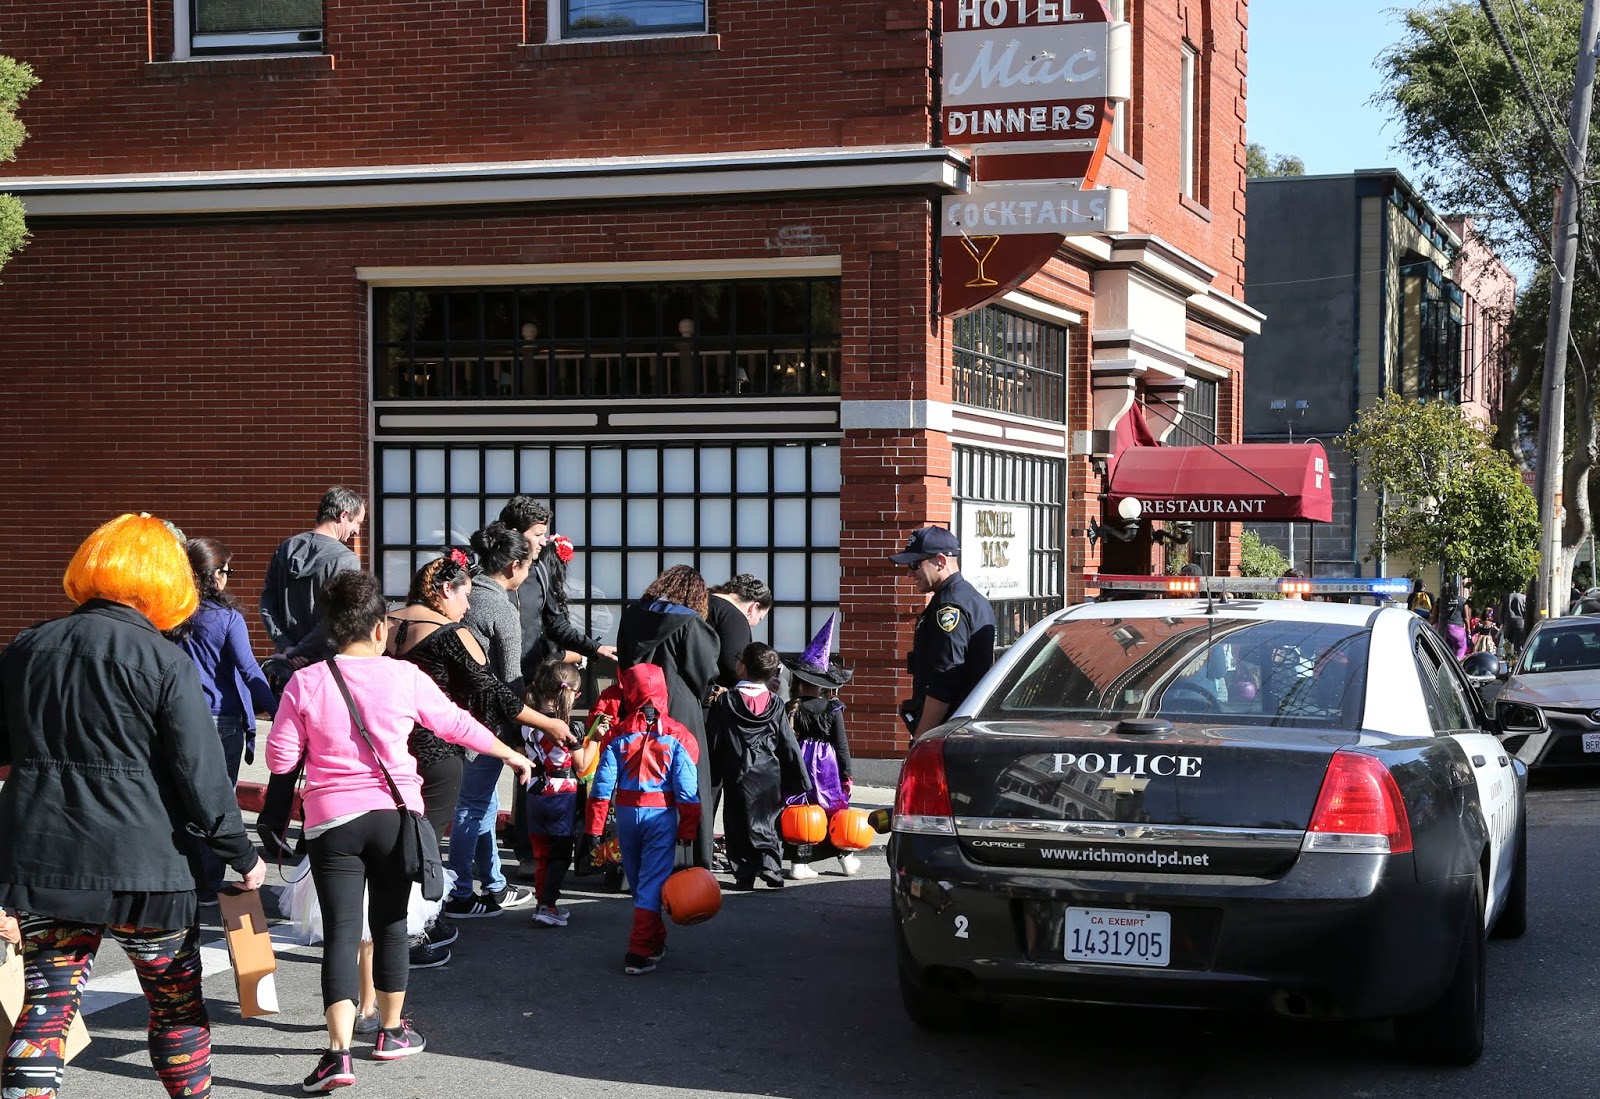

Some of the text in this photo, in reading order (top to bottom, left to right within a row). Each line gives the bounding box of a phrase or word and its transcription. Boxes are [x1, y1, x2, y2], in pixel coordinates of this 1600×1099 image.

[958, 0, 1084, 28] HOTEL
[949, 39, 1099, 95] Mac
[948, 105, 1095, 135] DINNERS
[947, 198, 1105, 228] COCKTAILS
[1141, 499, 1266, 513] RESTAURANT
[975, 509, 1015, 538] HOTEL
[1051, 752, 1202, 778] POLICE
[972, 840, 1026, 849] CAPRICE
[1040, 847, 1209, 868] www.richmondpd.net
[954, 914, 969, 939] 2
[1091, 916, 1145, 927] CA EXEMPT
[1071, 927, 1162, 958] 1431905
